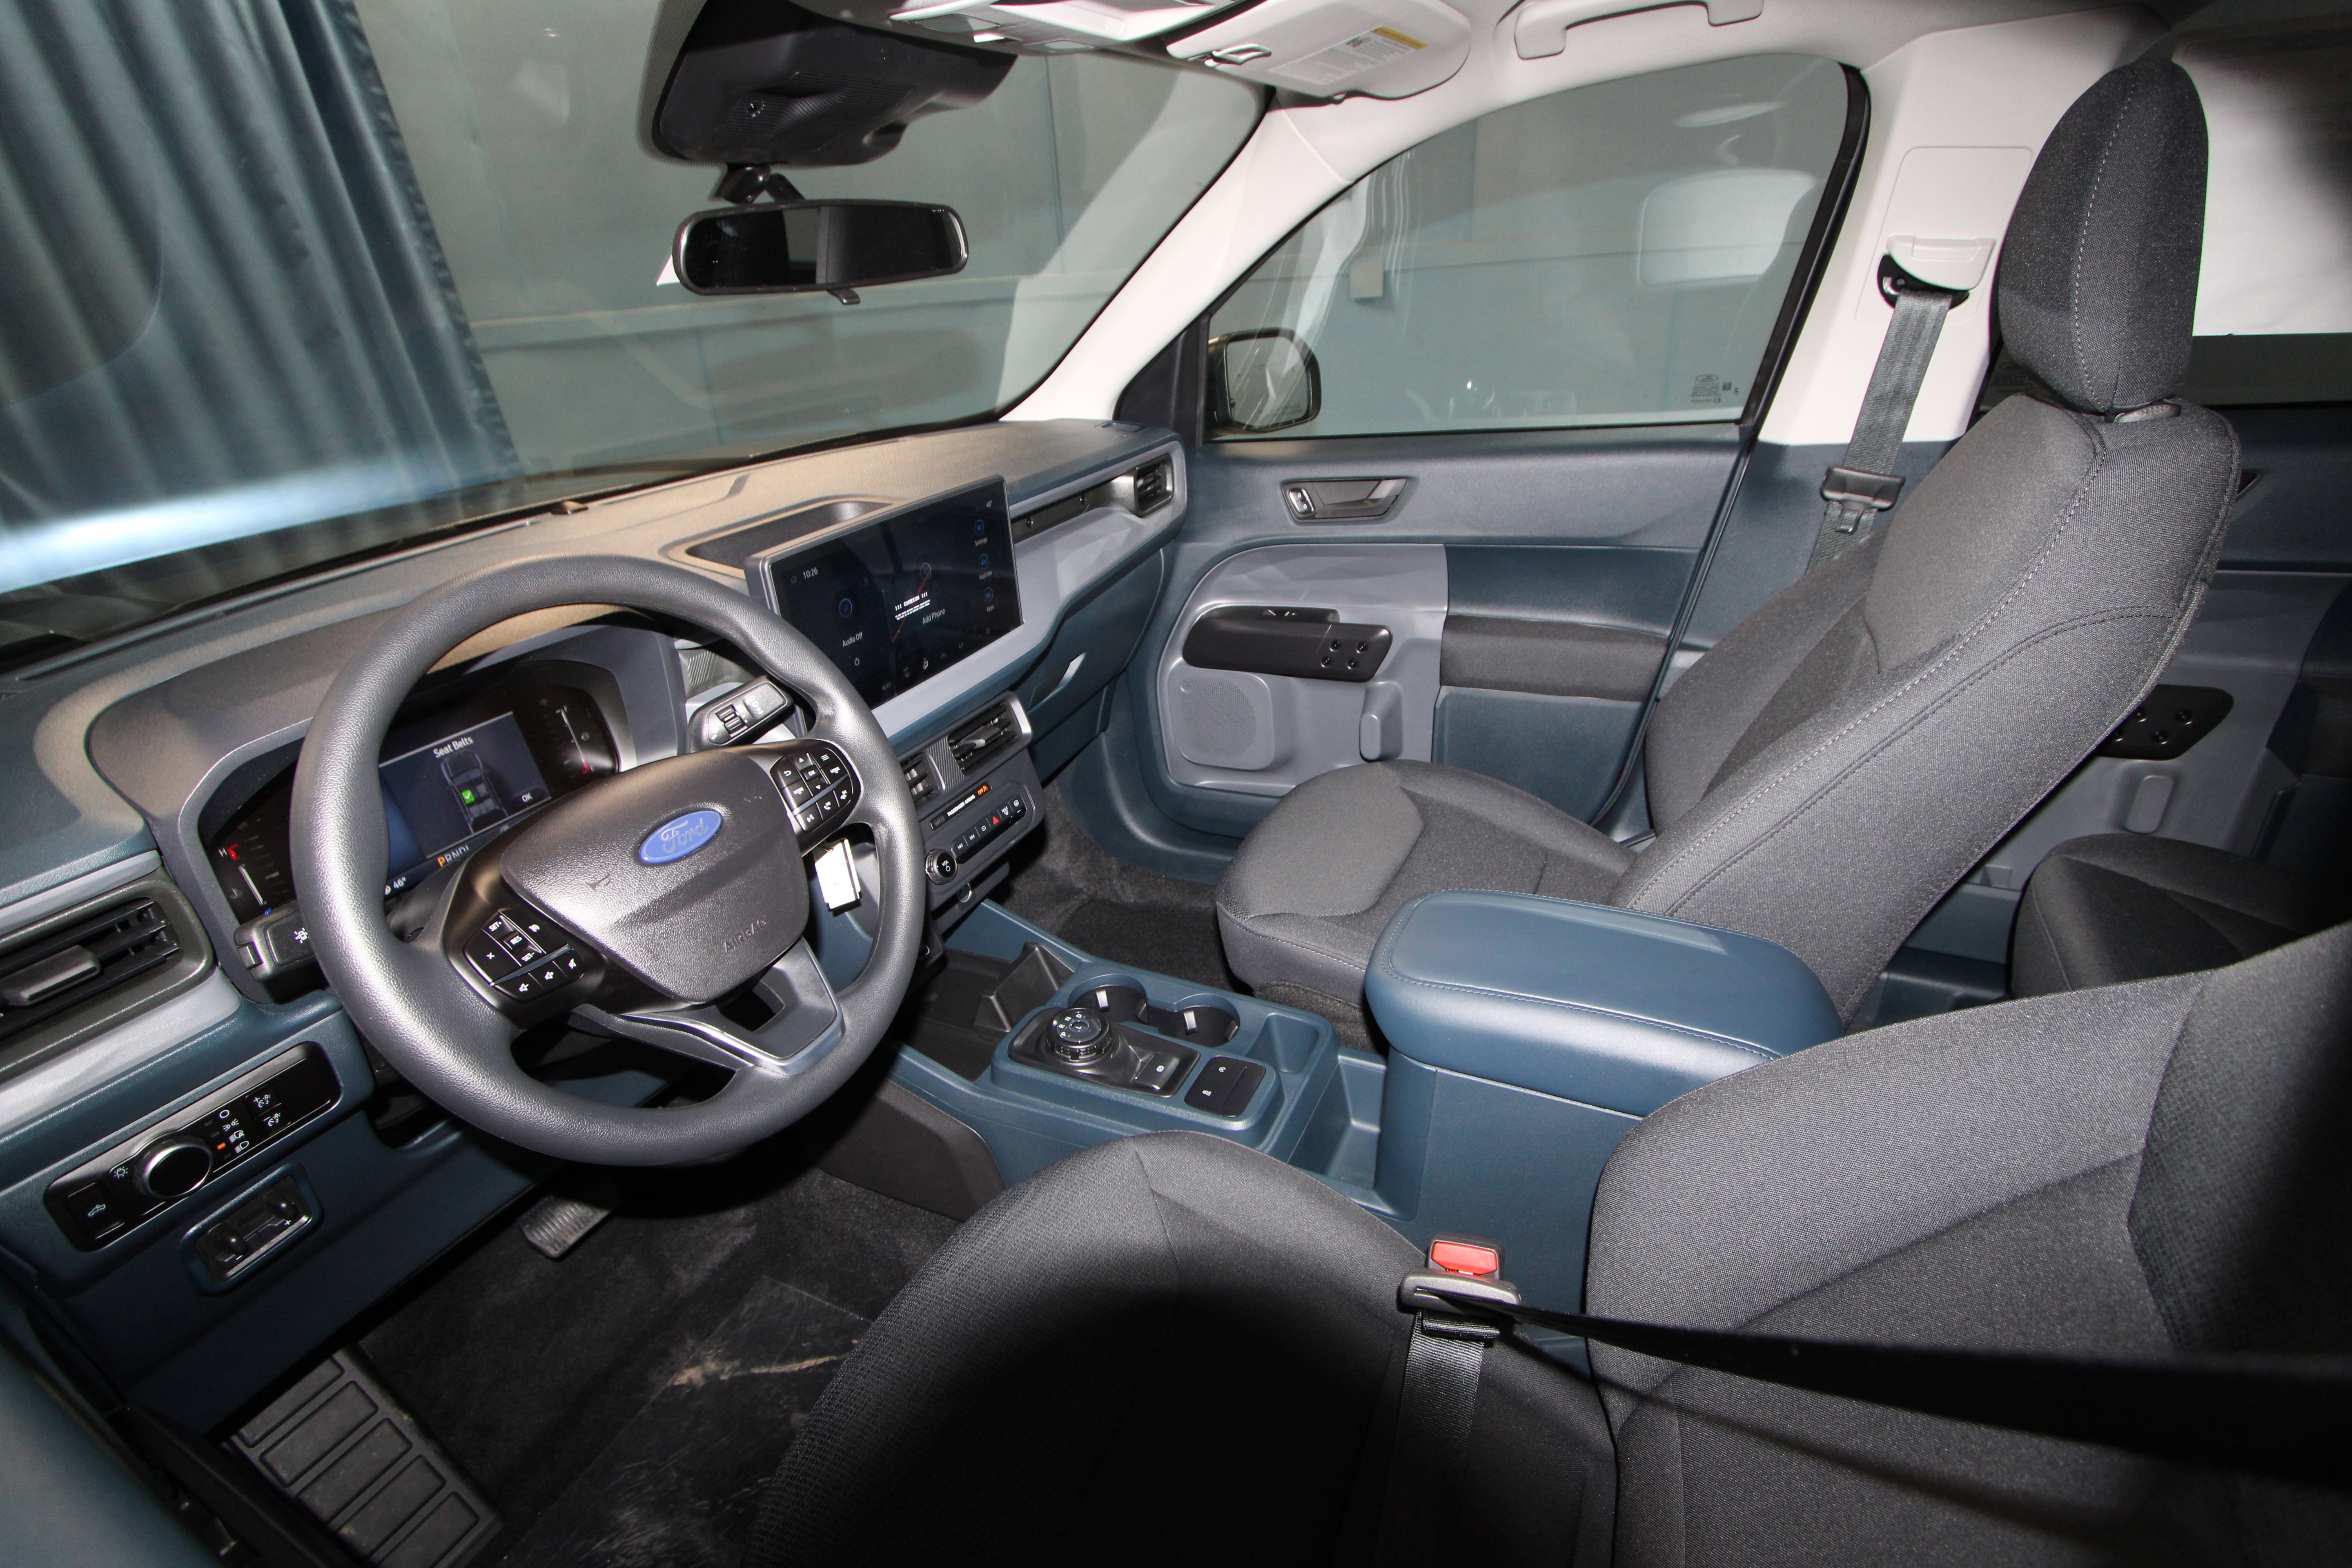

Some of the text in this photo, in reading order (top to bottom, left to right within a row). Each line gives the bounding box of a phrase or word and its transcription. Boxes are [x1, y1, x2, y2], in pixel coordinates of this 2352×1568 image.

[975, 537, 987, 546] Settings
[803, 567, 818, 579] 10:26
[979, 571, 992, 580] Features
[903, 595, 920, 606] CAUTION
[922, 614, 931, 624] Add
[931, 608, 945, 620] Phone
[842, 636, 855, 648] Audio
[882, 682, 892, 691] AUTO
[433, 736, 473, 758] Seat Belts
[521, 792, 532, 802] OK
[947, 801, 965, 817] PASSENGER
[964, 794, 976, 805] AIRBAG
[661, 817, 708, 853] Ford
[218, 847, 227, 857] H
[394, 876, 407, 889] 46°
[488, 921, 502, 931] SET+
[510, 935, 522, 945] RES
[724, 918, 767, 953] AIRBAG
[521, 952, 535, 962] SET-
